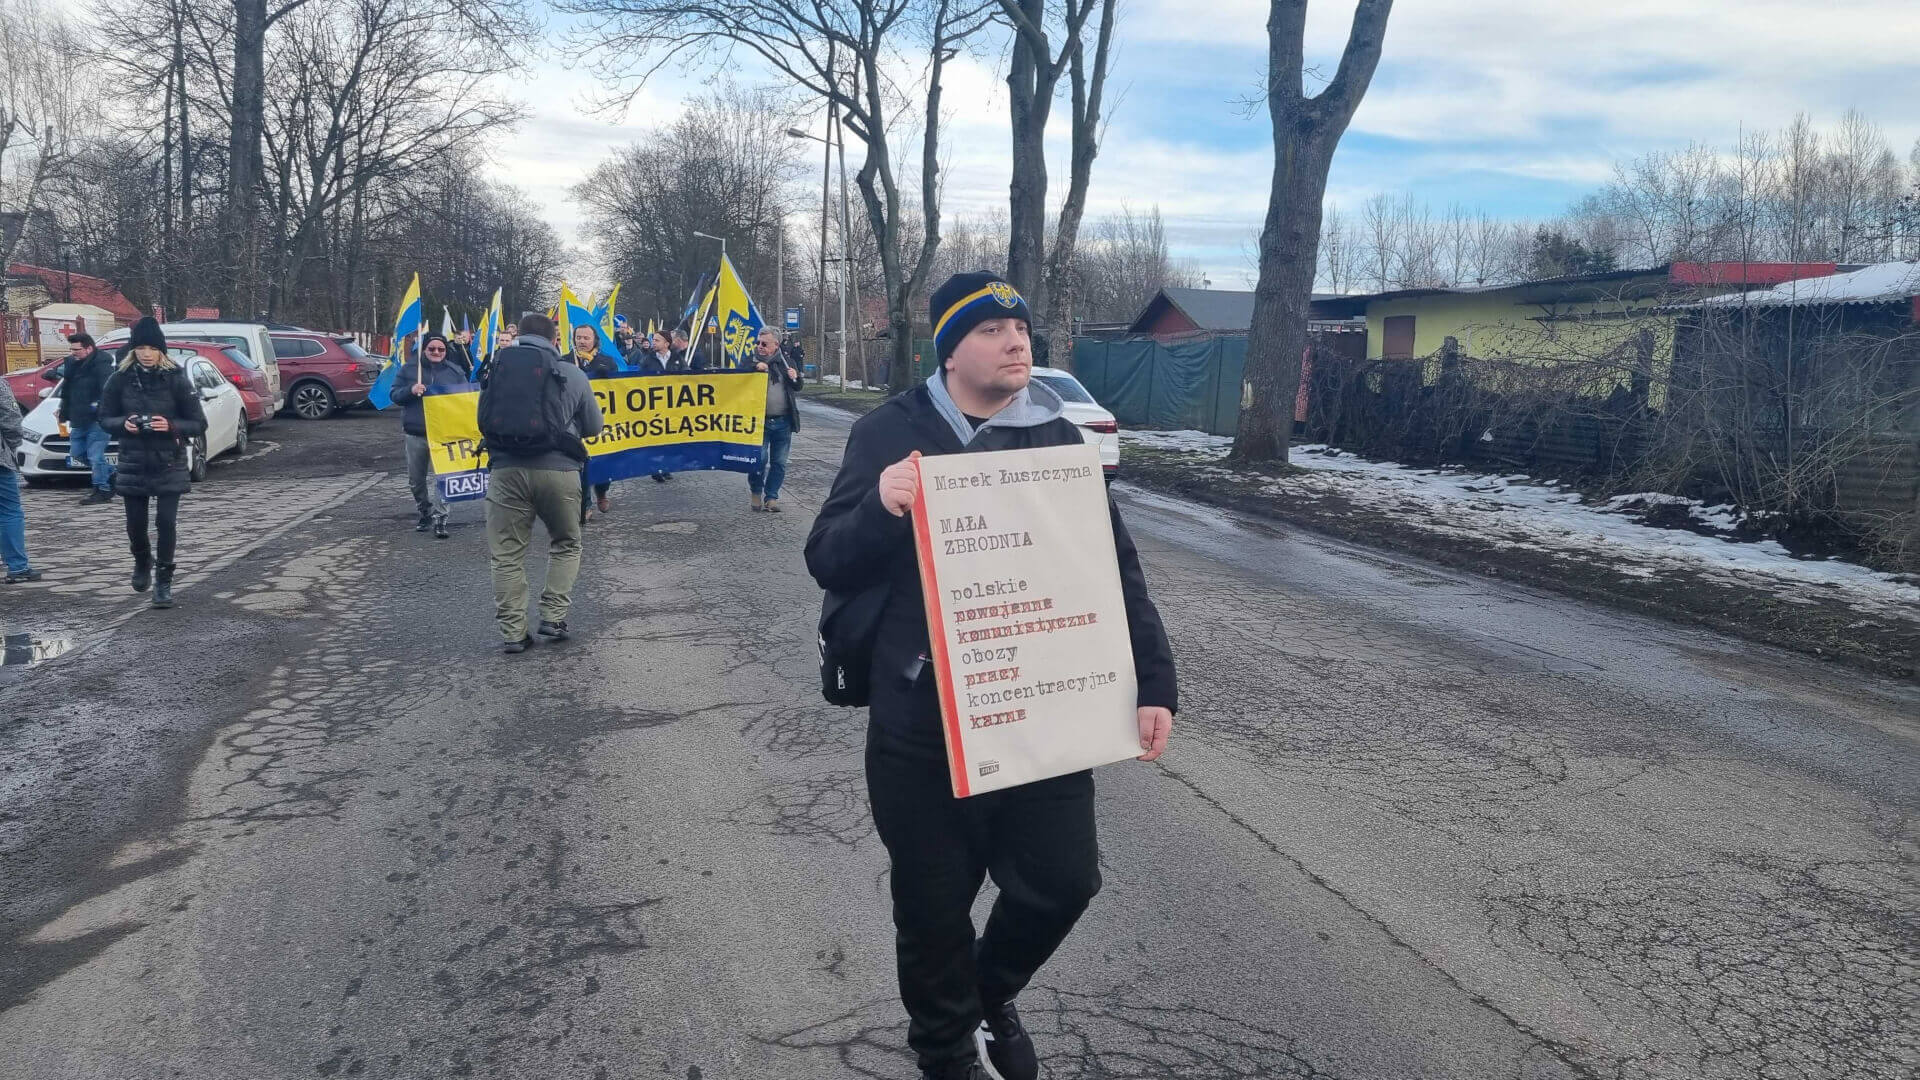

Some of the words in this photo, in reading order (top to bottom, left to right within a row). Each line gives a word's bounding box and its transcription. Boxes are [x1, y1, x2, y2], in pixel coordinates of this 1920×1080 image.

[626, 384, 715, 412] OFIAR
[933, 472, 992, 491] Marek
[998, 466, 1093, 485] Łuszczyna
[940, 514, 988, 534] MAŁA
[944, 531, 1034, 555] ZBRODNIA
[951, 578, 1029, 605] polskie
[953, 598, 1055, 624] powojenne
[957, 612, 1099, 645] komunistyczne
[962, 646, 1018, 665] obozy
[964, 666, 1020, 689] pracy
[967, 671, 1118, 708] koncentracyjne
[970, 708, 1027, 730] karne
